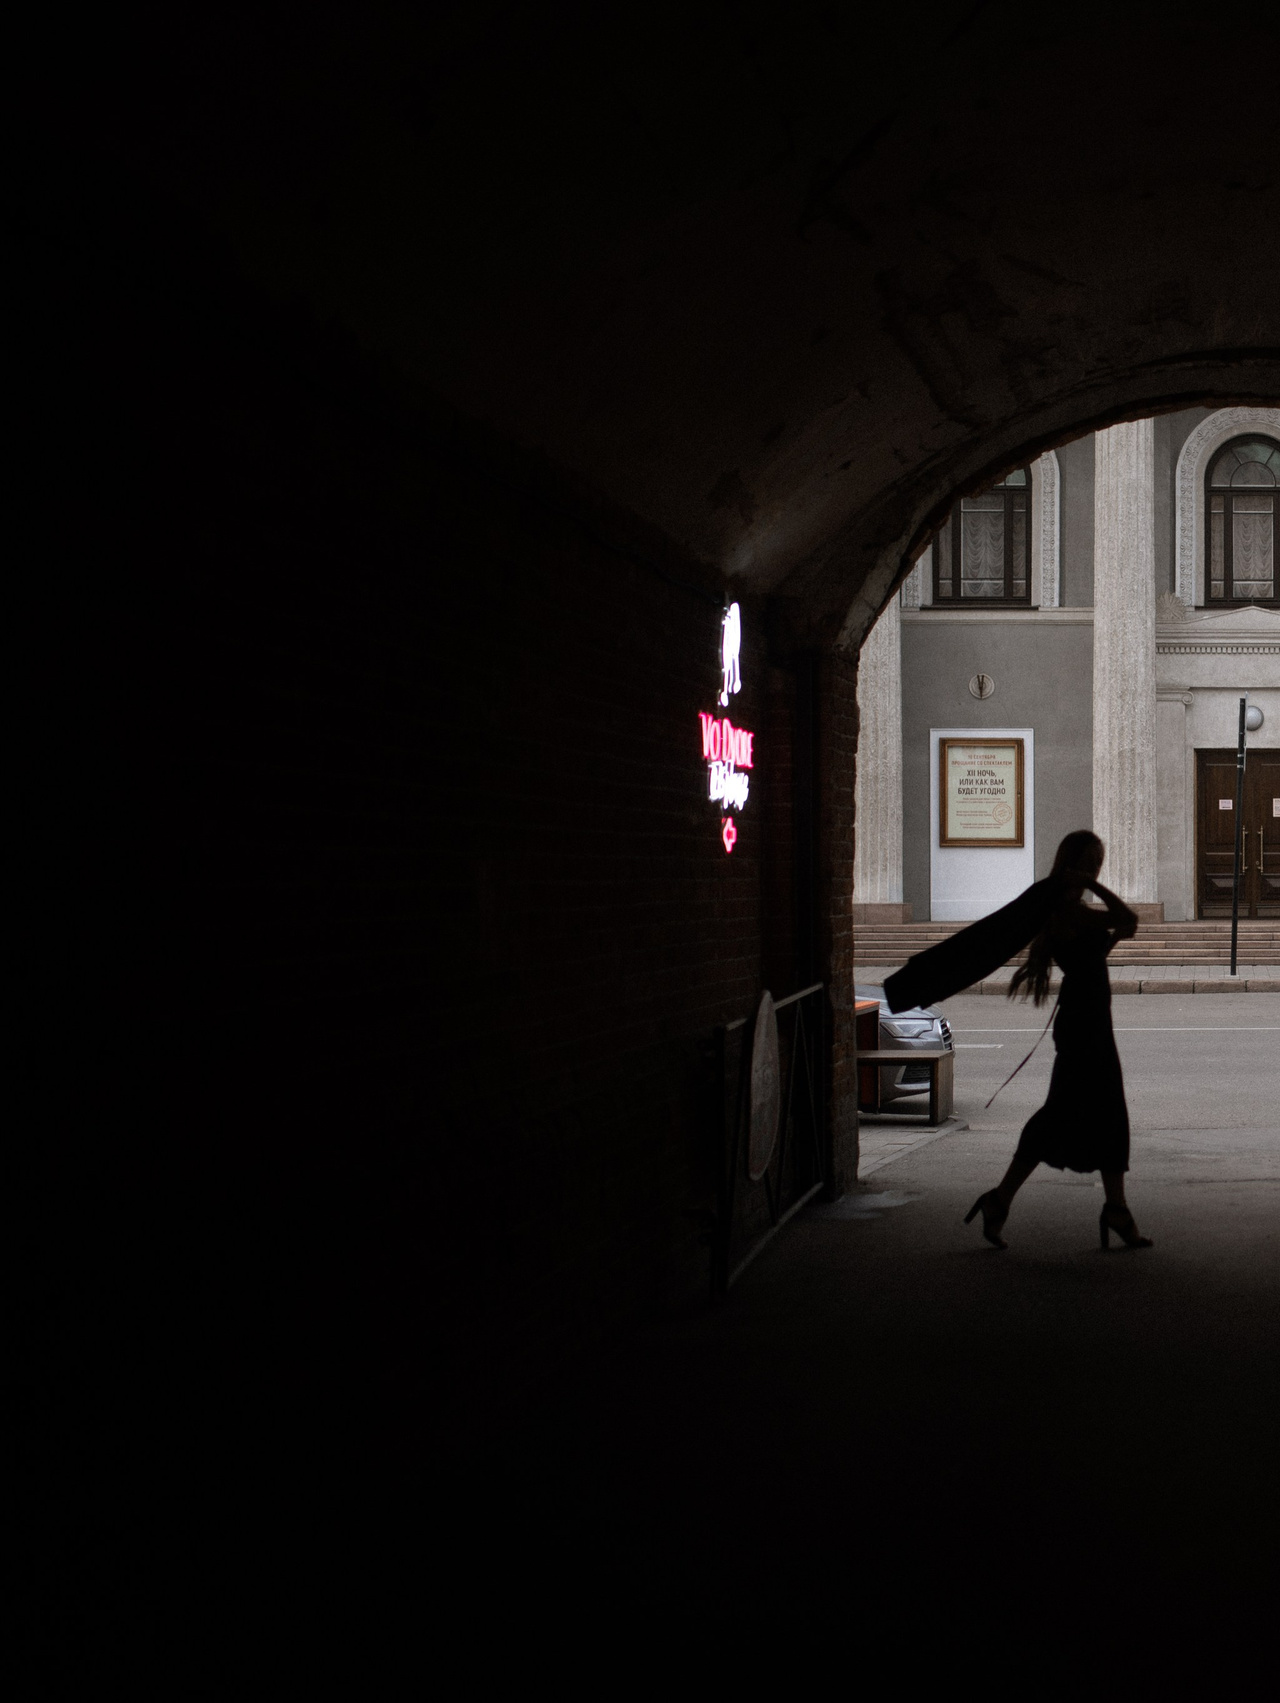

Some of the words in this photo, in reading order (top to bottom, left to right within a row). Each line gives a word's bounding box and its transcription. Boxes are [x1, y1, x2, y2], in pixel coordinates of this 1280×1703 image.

[977, 769, 997, 778] НОЧЬ,
[959, 778, 974, 786] ИЛИ
[975, 778, 989, 786] КАК
[989, 778, 1004, 786] ВАМ
[957, 787, 978, 796] БУДЕТ
[979, 787, 1006, 796] УГОДНО
